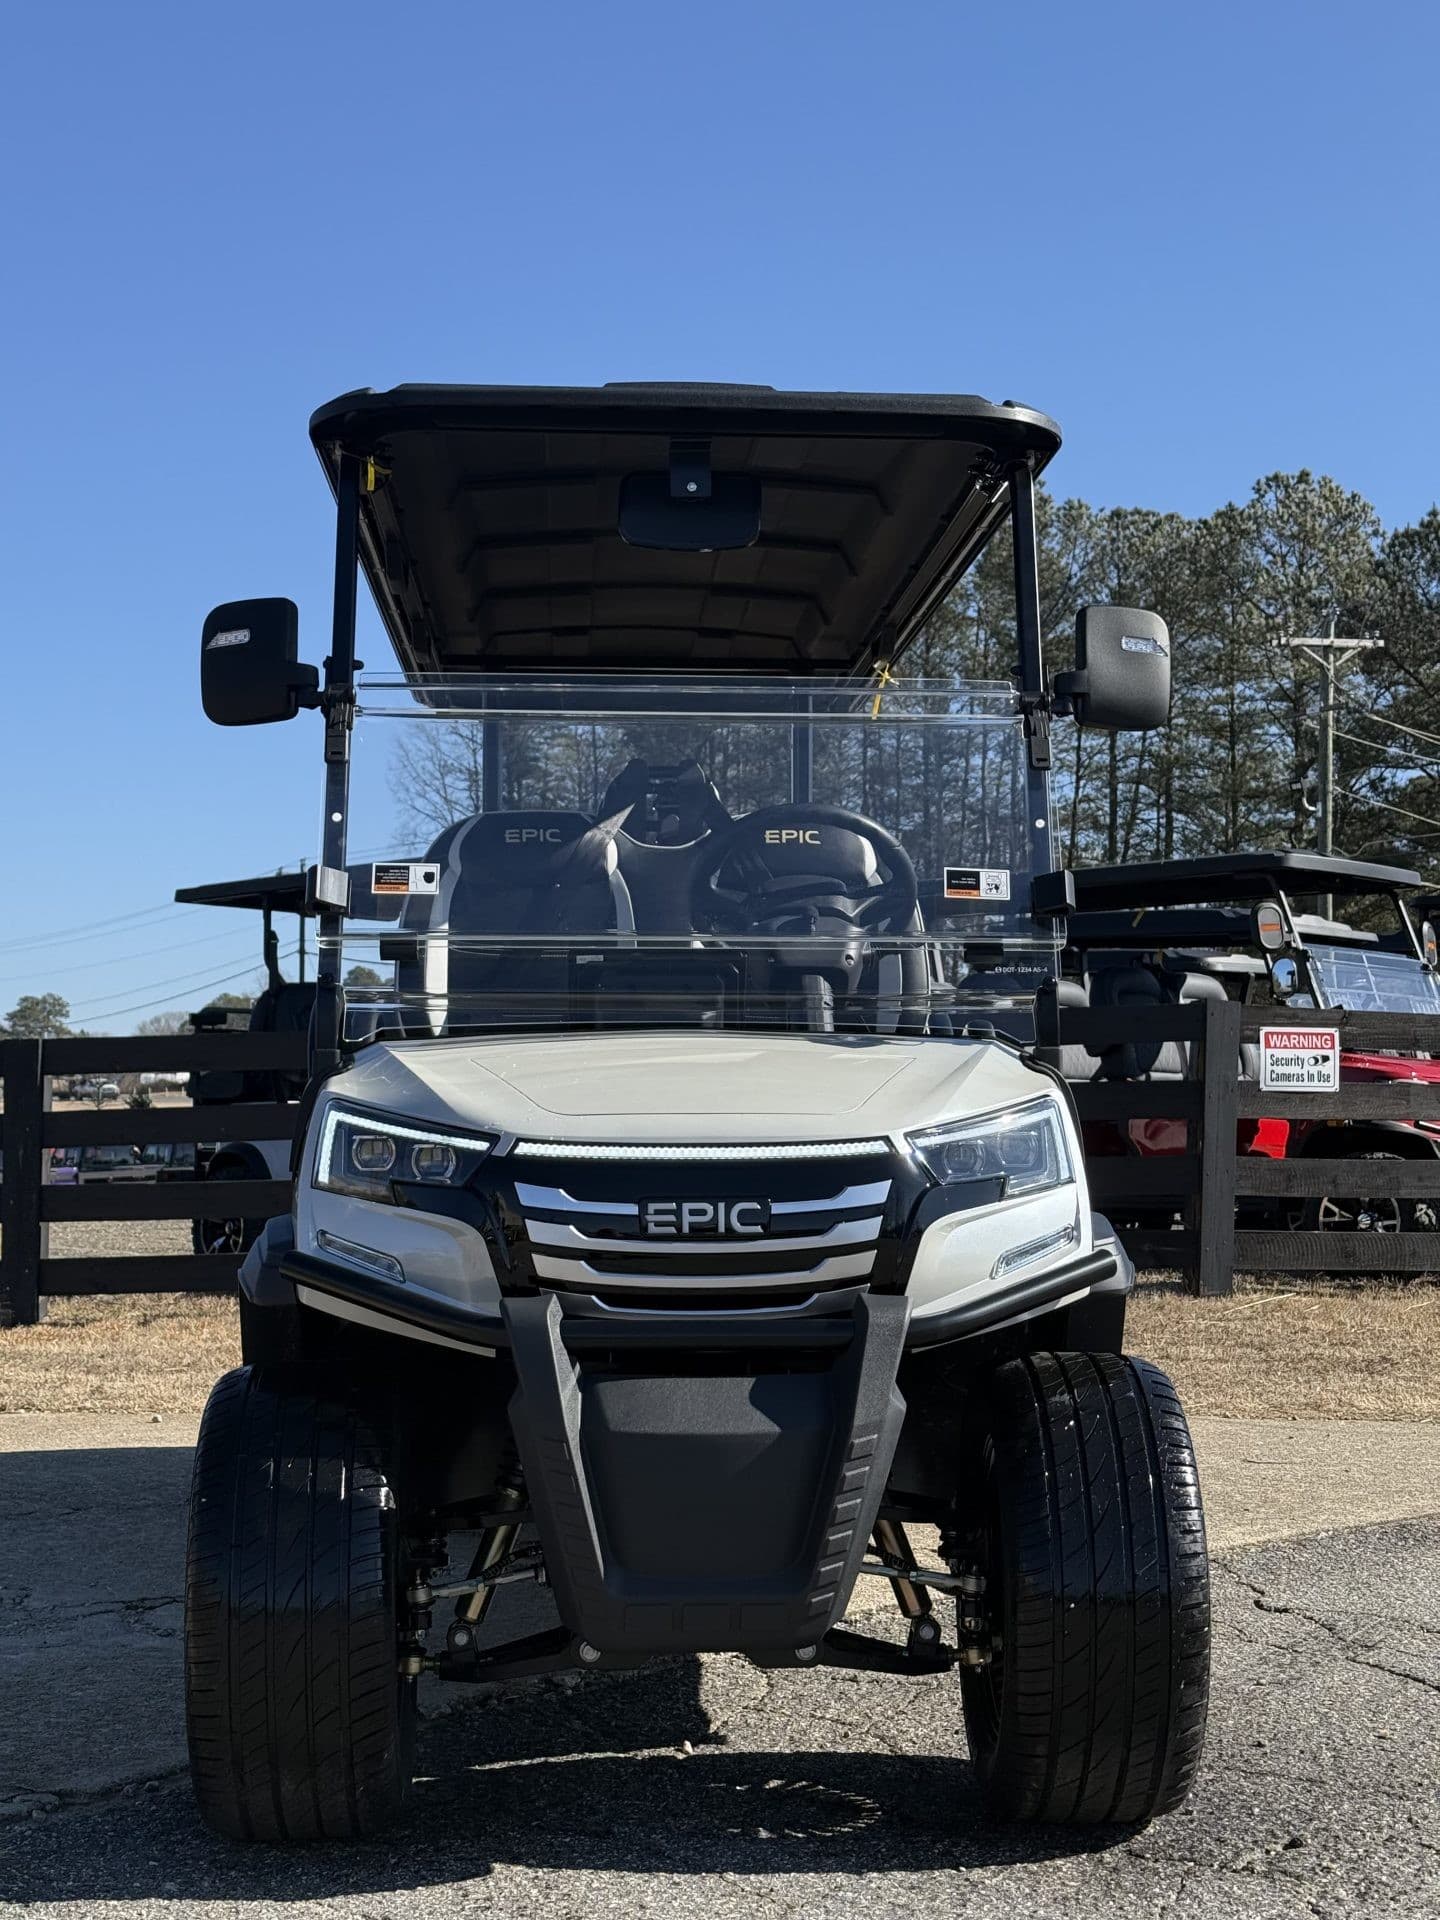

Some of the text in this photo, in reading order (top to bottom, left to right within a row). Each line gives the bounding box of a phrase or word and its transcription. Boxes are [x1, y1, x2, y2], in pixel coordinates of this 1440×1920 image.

[504, 828, 562, 843] EPIC
[764, 829, 822, 845] EPIC
[1268, 1034, 1332, 1049] WARNING
[1270, 1053, 1305, 1069] Security
[1270, 1069, 1331, 1083] Cameras In Use
[644, 1202, 764, 1233] EPIC
